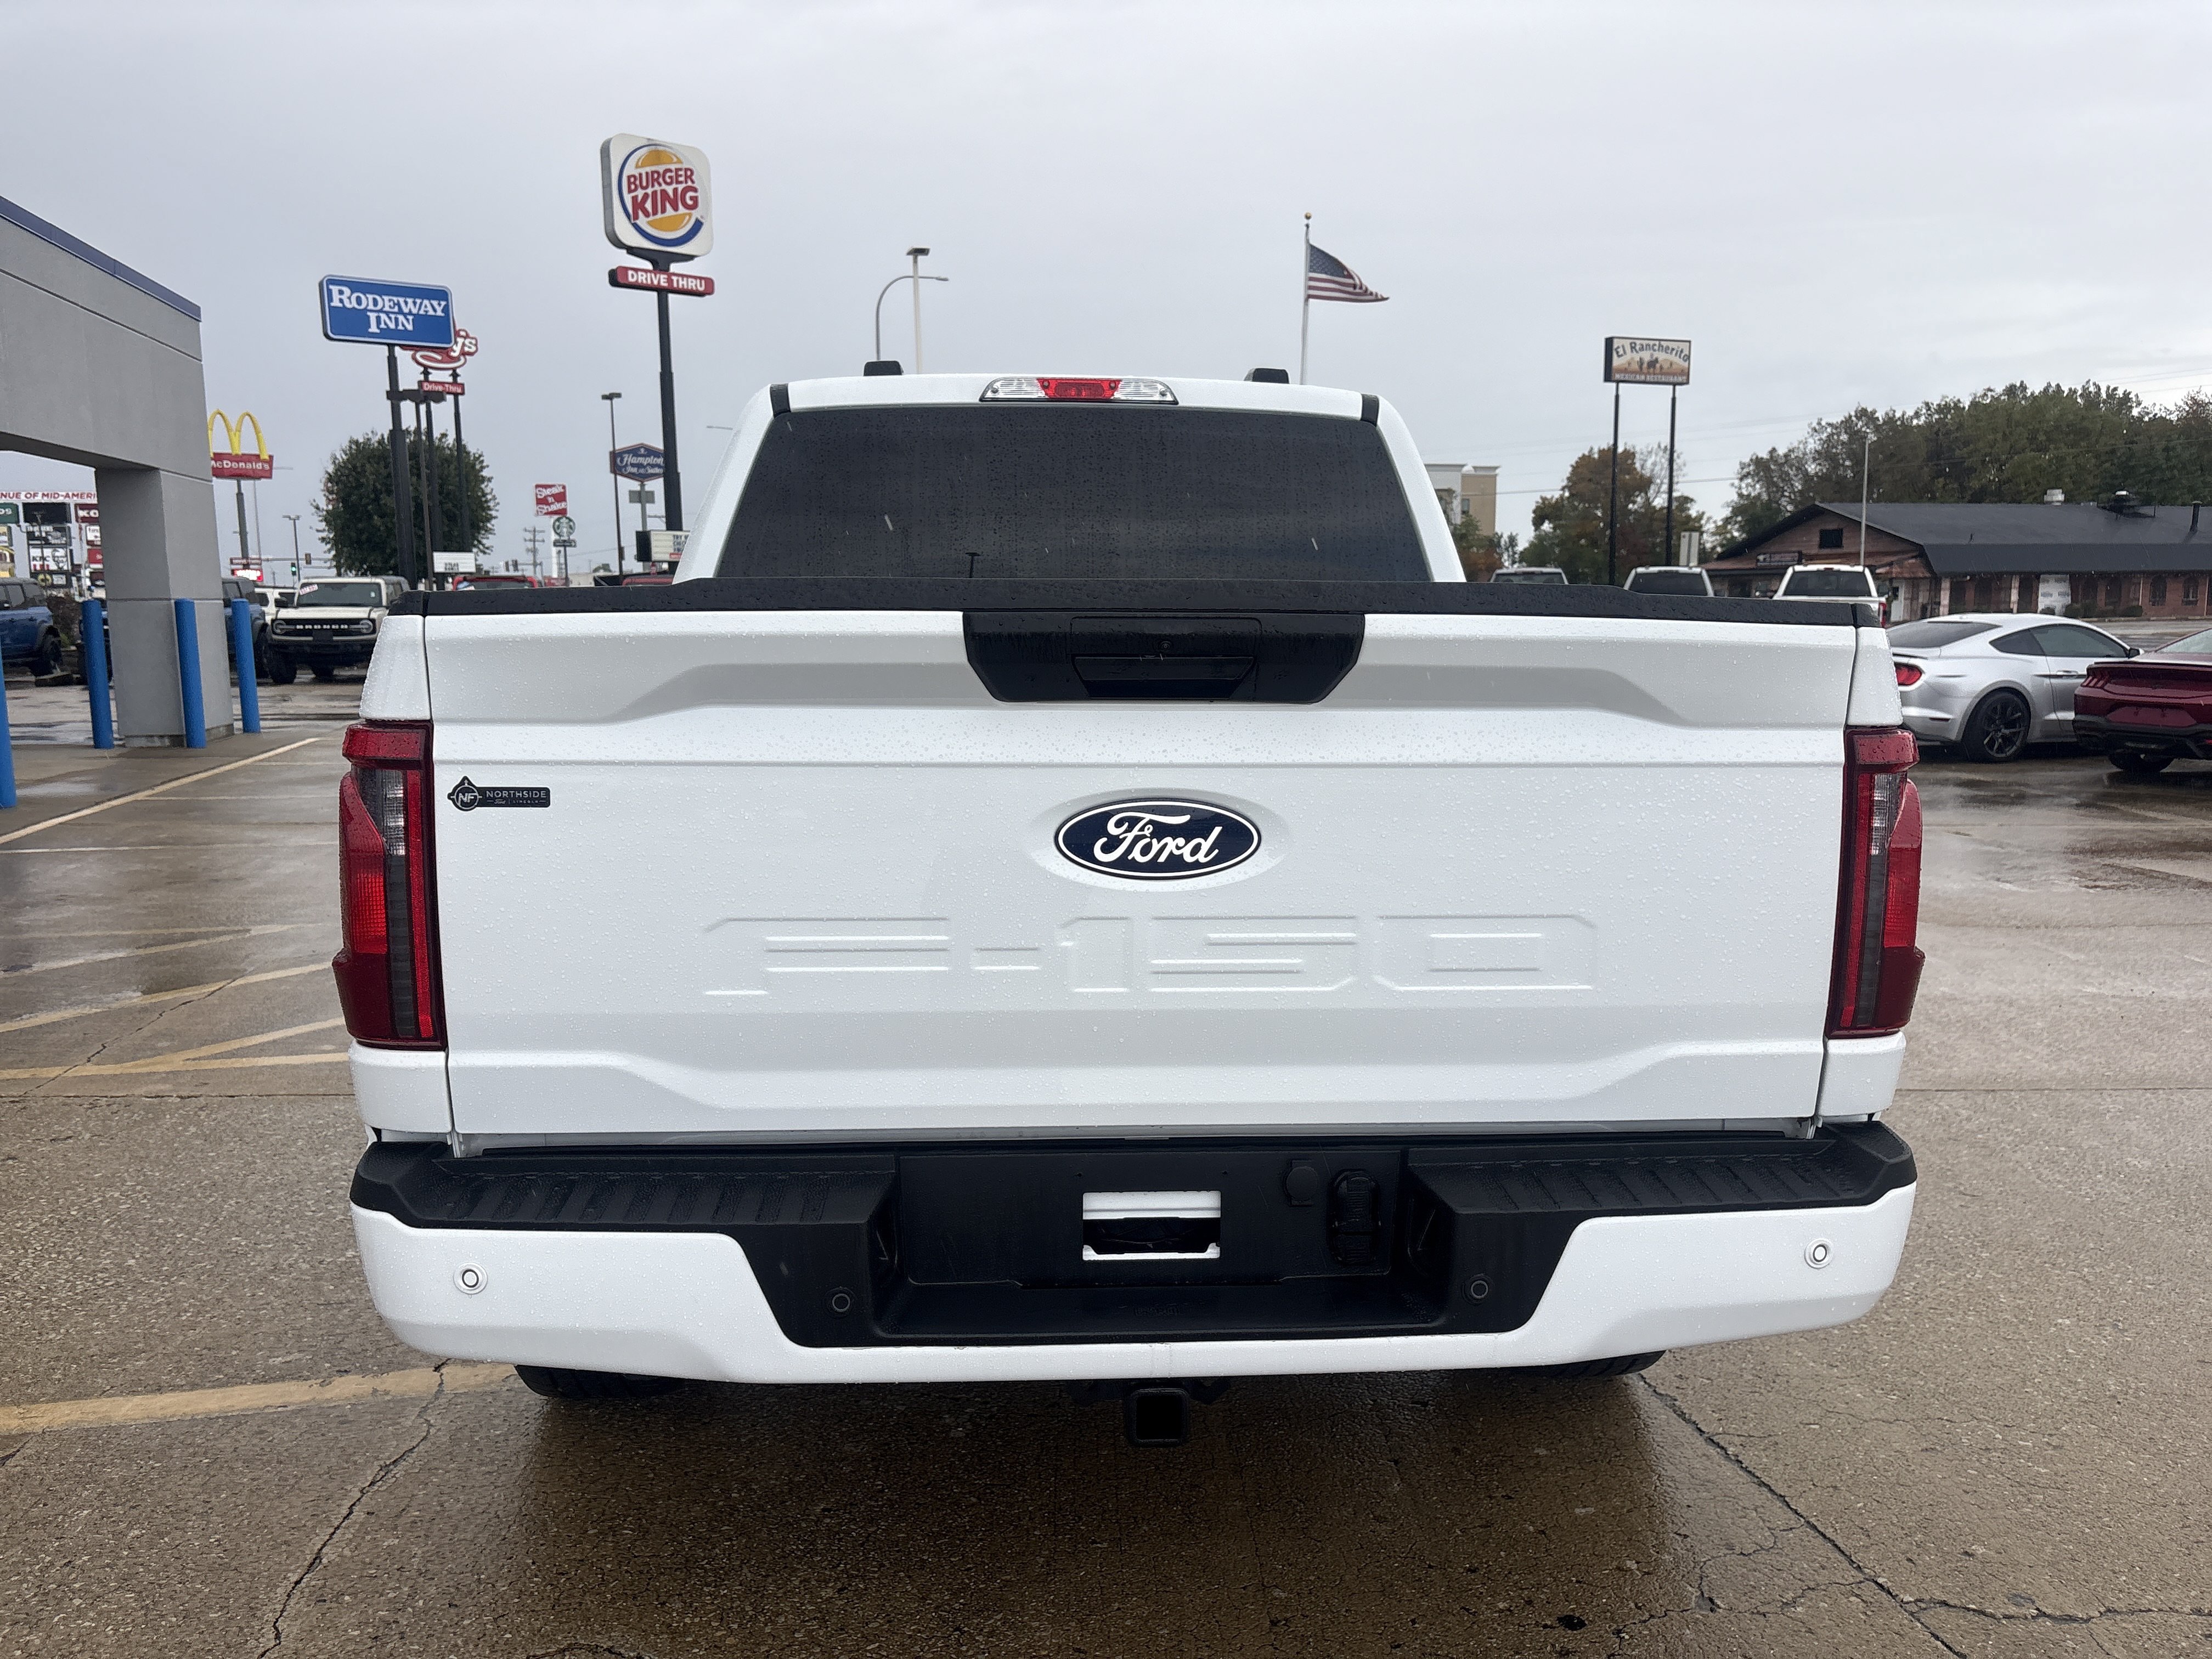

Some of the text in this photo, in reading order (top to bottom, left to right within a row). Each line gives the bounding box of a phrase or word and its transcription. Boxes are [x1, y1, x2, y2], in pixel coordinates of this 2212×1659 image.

[627, 167, 696, 194] BURGER
[631, 185, 699, 222] KING
[627, 270, 706, 291] DRIVE THRU
[329, 285, 447, 317] RODEWAY
[366, 311, 414, 334] INN
[1614, 341, 1689, 363] El Rancherito
[616, 453, 664, 466] Hampton
[1093, 811, 1223, 863] Ford
[704, 915, 1595, 996] F-150
